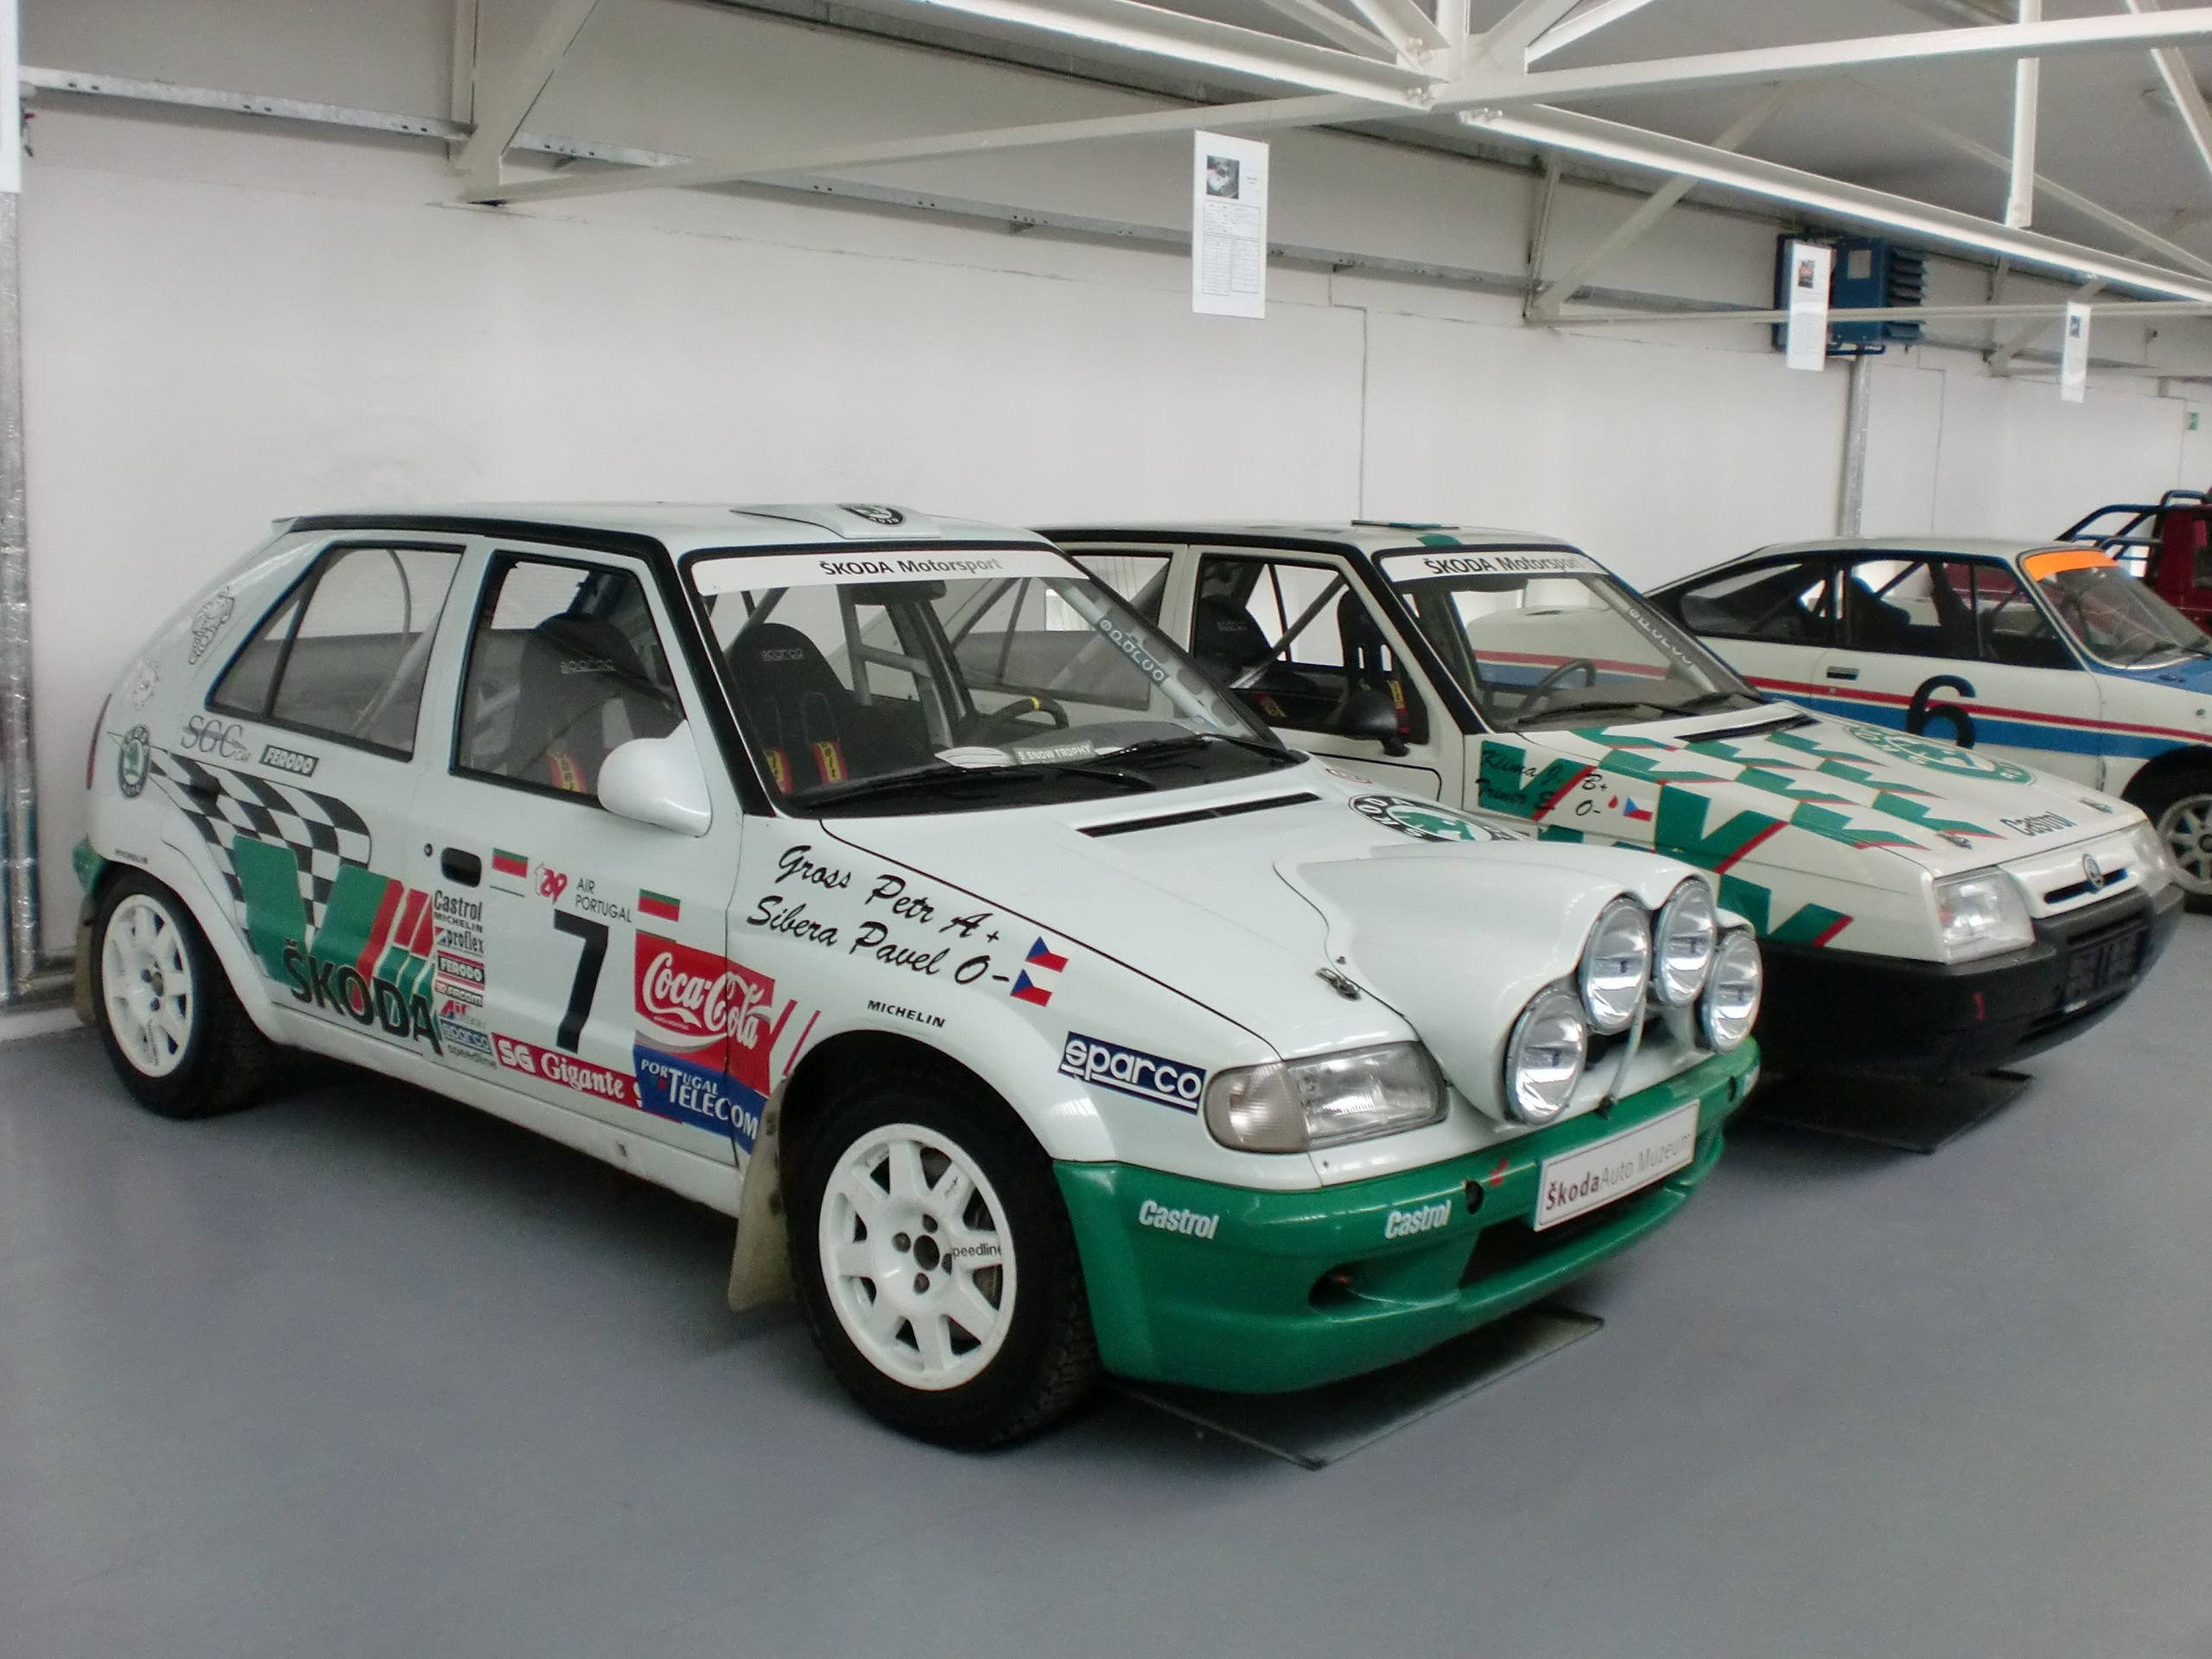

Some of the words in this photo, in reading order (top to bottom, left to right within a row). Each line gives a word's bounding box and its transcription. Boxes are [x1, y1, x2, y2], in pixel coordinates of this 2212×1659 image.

[820, 560, 894, 575] ŠKODA
[897, 558, 1002, 575] Motorsport
[1424, 558, 1496, 575] ŠKODA
[1100, 620, 1165, 681] sparco
[1906, 675, 1976, 750] 6
[264, 747, 315, 774] FERODO
[1028, 748, 1055, 760] SNOW
[1054, 744, 1090, 758] TROPHY
[1999, 810, 2078, 836] Castrol
[576, 878, 595, 895] AIR
[776, 845, 851, 890] Gross
[865, 874, 935, 924] Petr
[434, 912, 483, 933] MICHELIN
[435, 890, 483, 922] Castrol
[575, 893, 632, 924] PORTUGAL
[747, 895, 838, 947] Sibera
[849, 920, 950, 976] Pavel
[440, 957, 484, 982] FERODO
[554, 909, 609, 1054] 7
[283, 937, 443, 1057] ŠKODA
[642, 952, 772, 1050] Coca-Cola
[867, 999, 946, 1028] MICHELIN
[498, 1039, 535, 1073] SG
[540, 1052, 625, 1101] Gigante
[1065, 1039, 1202, 1100] sparco
[669, 1066, 759, 1141] TELECOM
[1139, 1199, 1219, 1240] Castrol
[1384, 1199, 1452, 1239] Castrol
